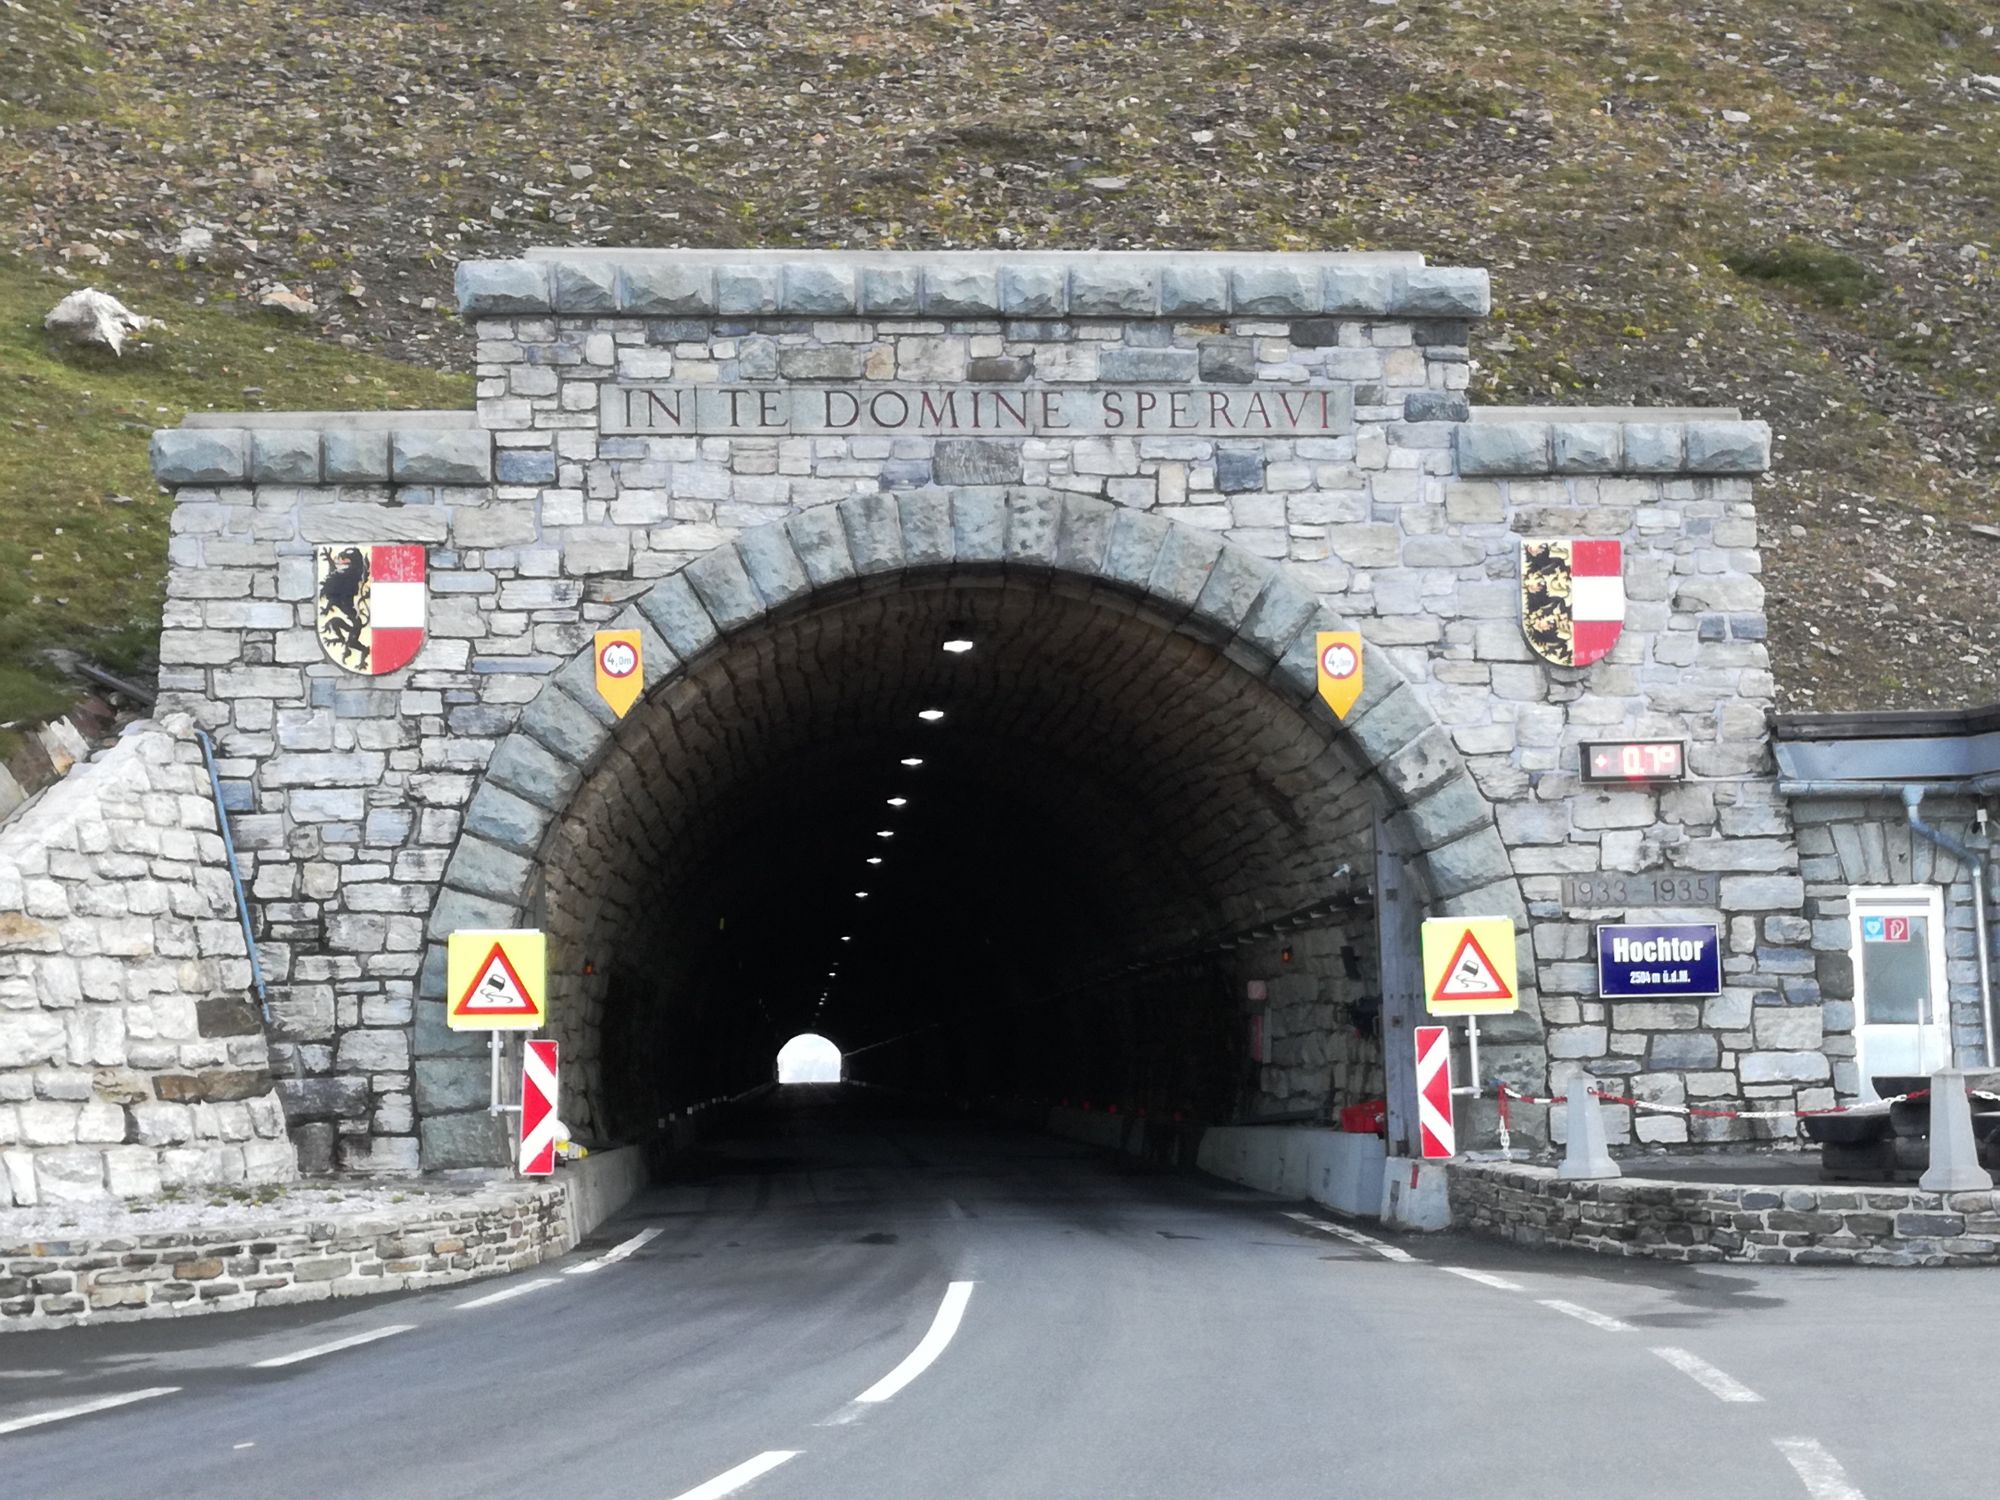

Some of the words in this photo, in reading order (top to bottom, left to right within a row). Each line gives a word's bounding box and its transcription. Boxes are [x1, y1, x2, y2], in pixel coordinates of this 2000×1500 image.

[623, 389, 683, 428] IN
[718, 389, 789, 428] TE
[823, 389, 1071, 429] DOMINE
[1102, 389, 1333, 430] SPERAVI
[1570, 879, 1629, 904] 1933
[1650, 878, 1710, 903] 1935
[1612, 936, 1704, 963] Hochtor
